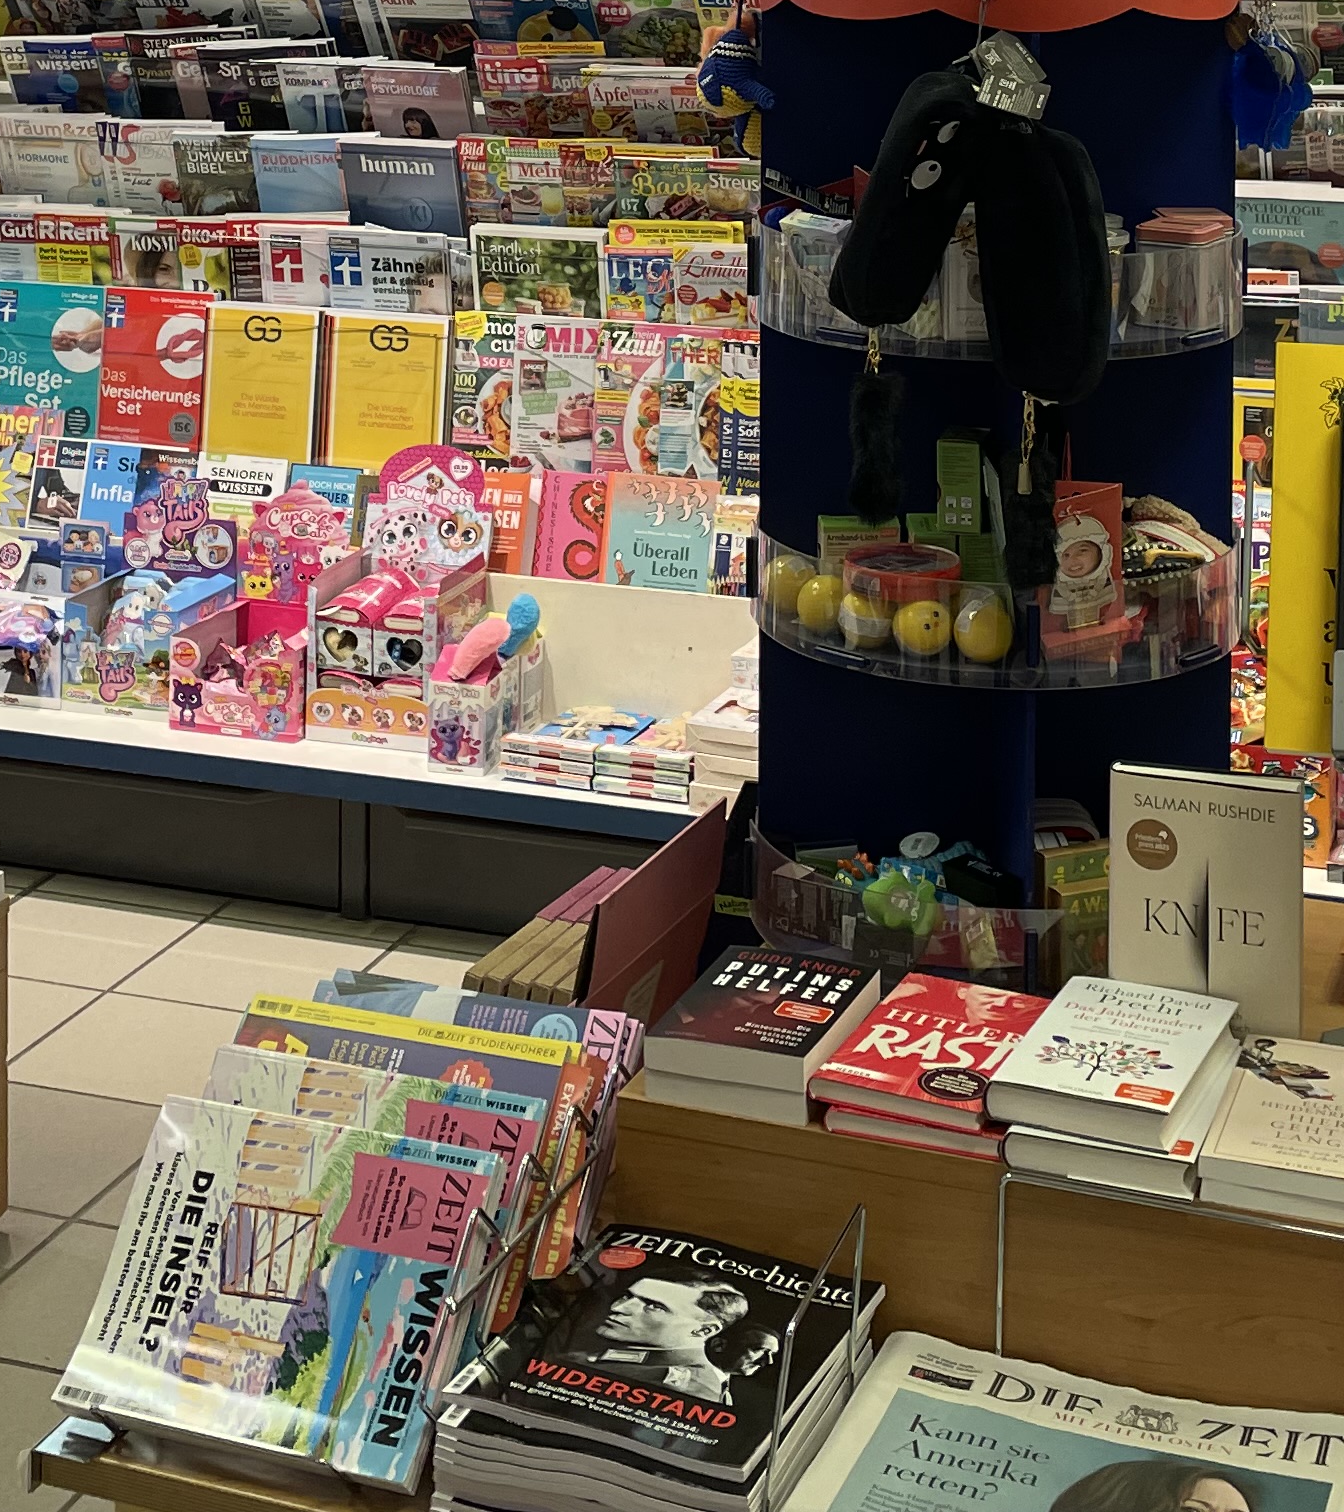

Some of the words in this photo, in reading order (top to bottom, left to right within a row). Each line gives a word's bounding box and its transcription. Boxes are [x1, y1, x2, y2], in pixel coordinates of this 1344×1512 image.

[484, 60, 540, 85] tina
[186, 150, 249, 164] UMWELT
[186, 161, 226, 175] BIBEL
[359, 154, 435, 177] human
[58, 220, 110, 242] Rent
[371, 256, 425, 275] Zähne
[480, 257, 541, 275] Edition
[101, 367, 127, 382] Das
[101, 385, 201, 407] Versicherungs
[116, 401, 142, 416] Set
[210, 467, 273, 482] SENIOREN
[218, 481, 264, 495] WISSEN
[633, 539, 689, 561] Überall
[651, 559, 698, 580] Leben
[1133, 794, 1202, 814] SALMAN
[1208, 801, 1276, 824] RUSHDIE
[712, 973, 841, 1006] HELFER
[723, 960, 854, 992] PUTINS
[1085, 983, 1149, 1005] Richard
[1155, 992, 1213, 1012] David
[1099, 994, 1183, 1017] Precht
[418, 1027, 434, 1038] DIE
[446, 1030, 465, 1044] ZEIT
[468, 1034, 556, 1059] STUDIENFÜHRER
[435, 1152, 478, 1168] WISSEN
[179, 1170, 215, 1228] DIE
[426, 1172, 472, 1263] ZEIT
[197, 1222, 219, 1269] REIF
[139, 1236, 195, 1352] INSEL?
[179, 1272, 203, 1314] FÜR
[367, 1264, 450, 1449] WISSEN
[525, 1357, 737, 1429] WIDERSTAND
[985, 1369, 1104, 1420] DIE
[907, 1413, 998, 1452] Kann
[1008, 1444, 1051, 1465] sie
[893, 1438, 1040, 1487] Amerika
[882, 1463, 999, 1502] retten?
